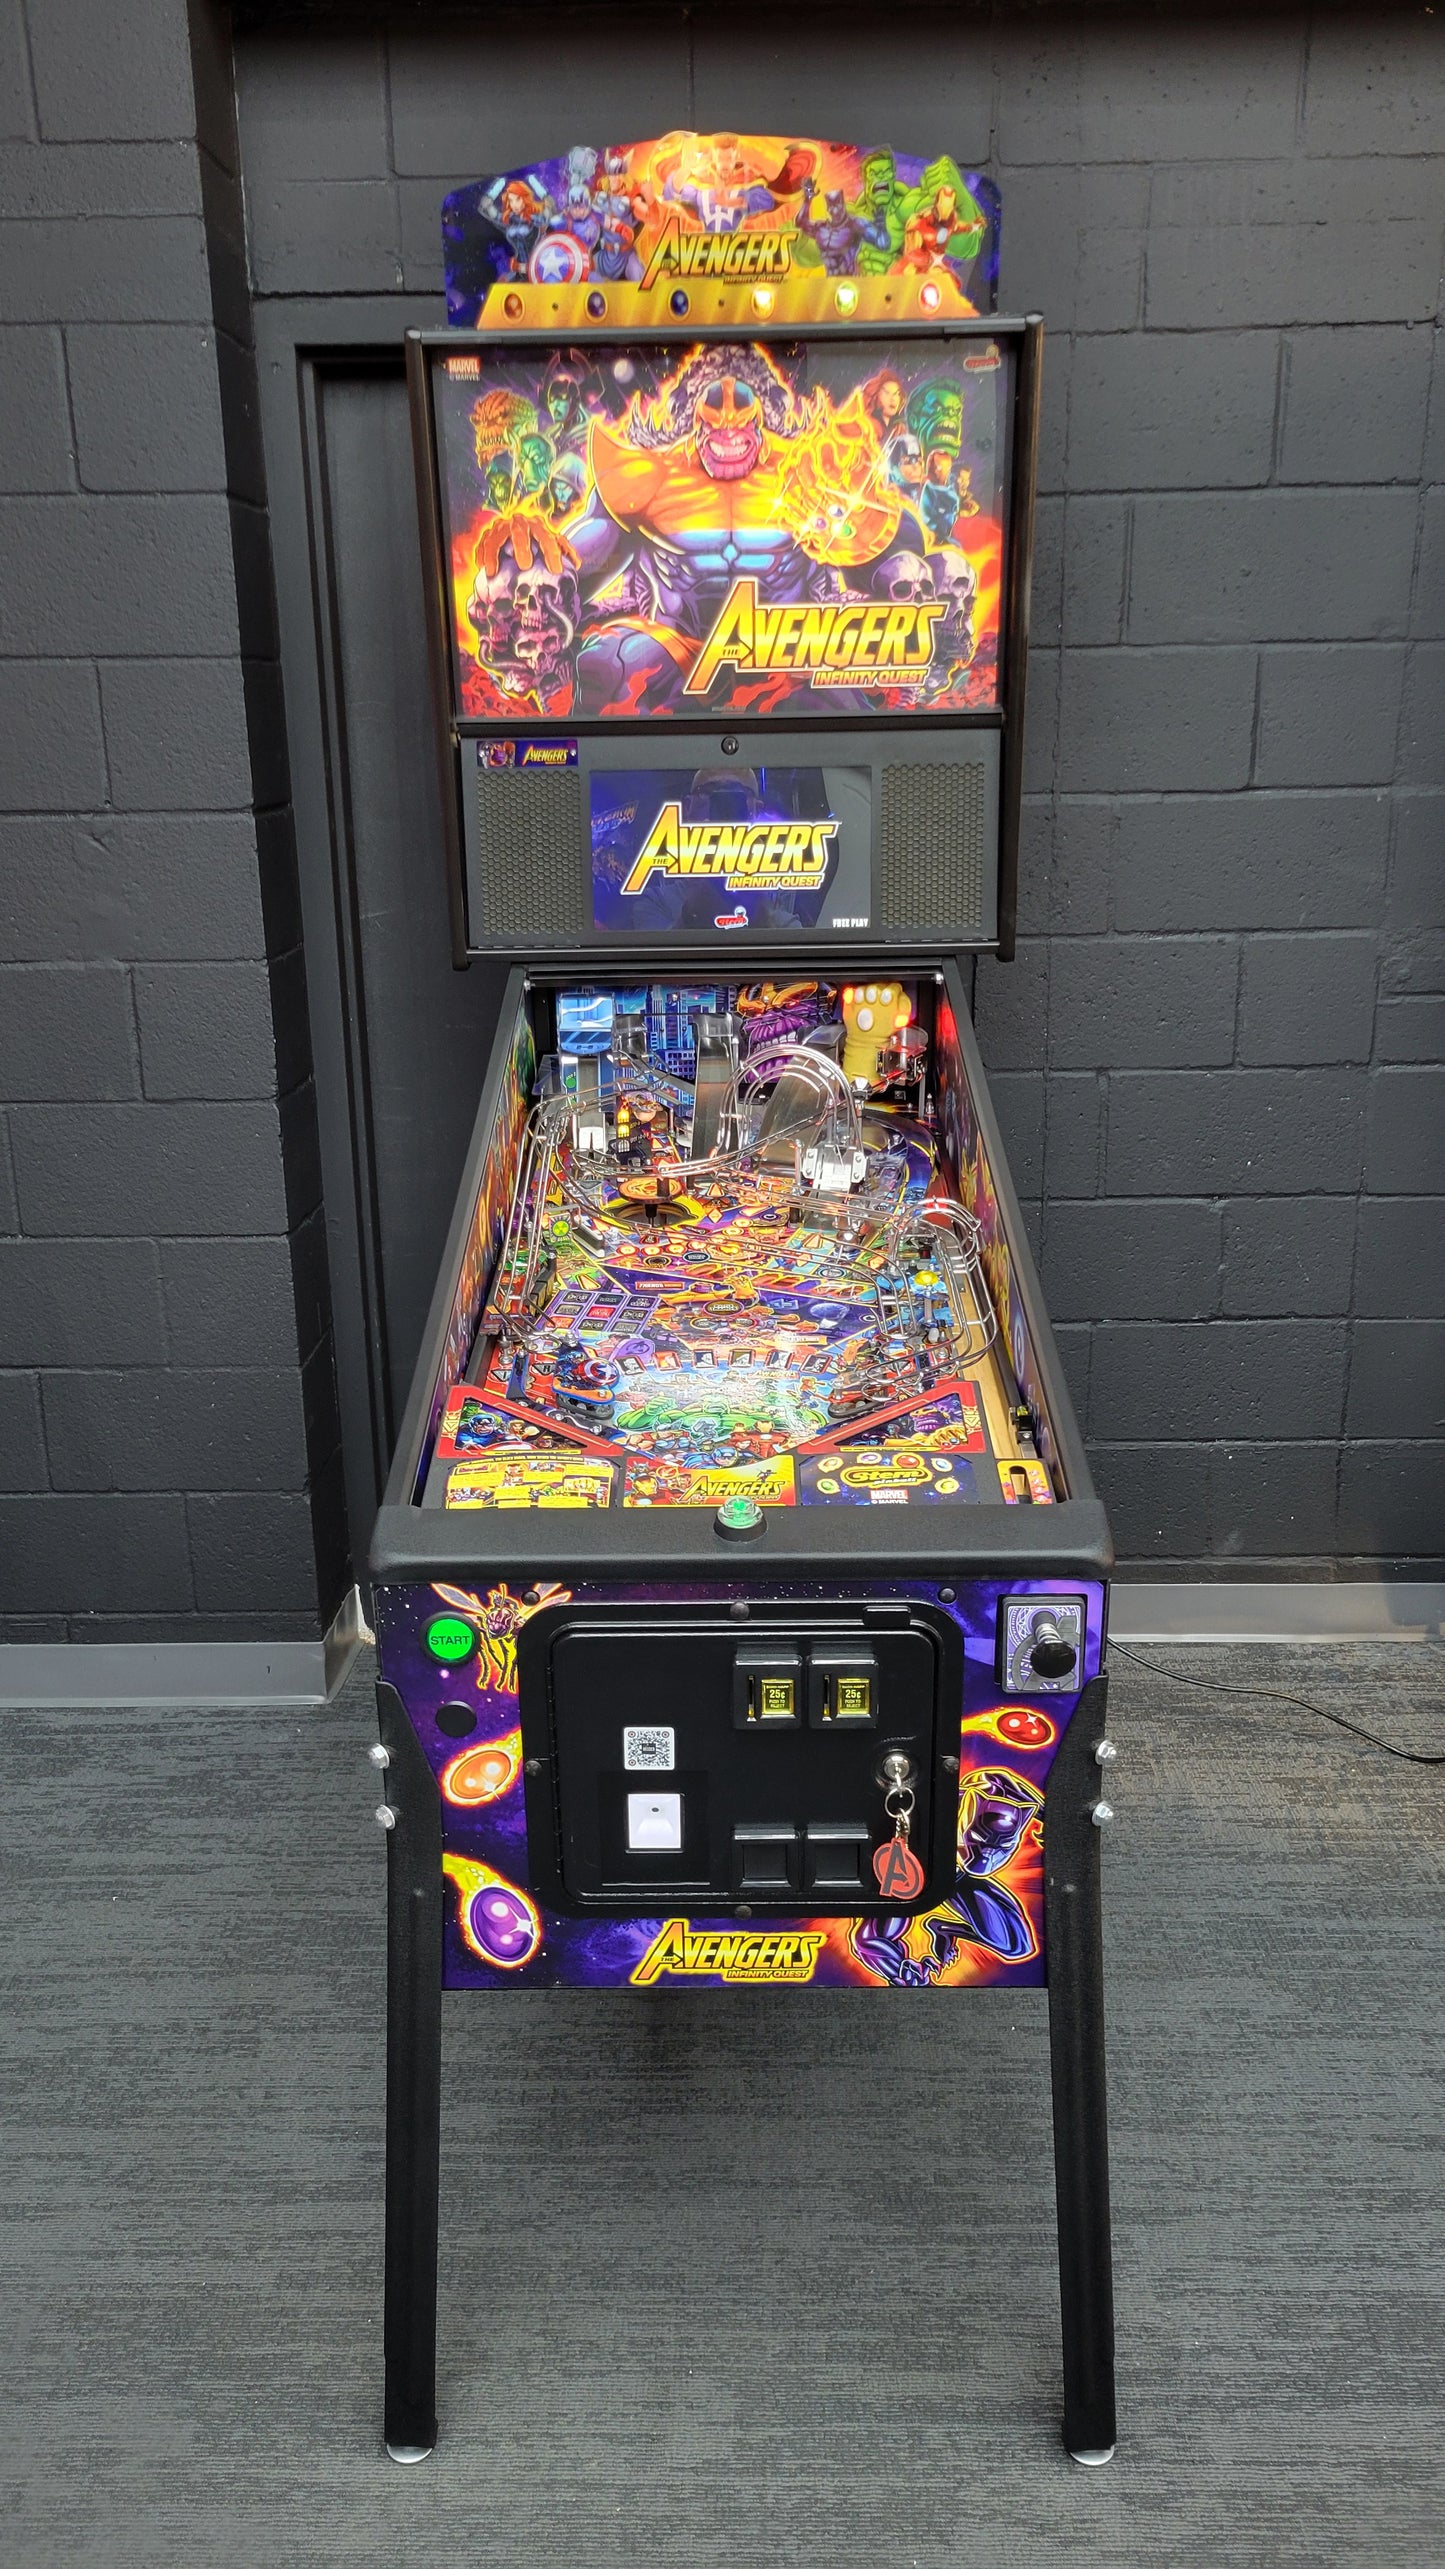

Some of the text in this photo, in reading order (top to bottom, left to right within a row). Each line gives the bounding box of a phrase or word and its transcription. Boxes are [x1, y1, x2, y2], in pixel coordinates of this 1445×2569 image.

[638, 216, 799, 292] AVENGERS
[449, 359, 480, 373] MARVEL
[688, 580, 947, 690] THE AVENGERS
[814, 671, 928, 685] INFINITY QUEST
[521, 744, 568, 766] AVENGERS
[625, 804, 838, 892] AVENGERS
[728, 876, 822, 888] INFINITY QUEST
[832, 918, 869, 928] FREE PLAY
[852, 1470, 919, 1482] Stern
[679, 1476, 785, 1501] AVENGERS
[871, 1490, 908, 1499] MARVEL
[431, 1635, 470, 1646] START
[769, 1689, 786, 1699] 25¢
[845, 1689, 862, 1699] 25¢
[636, 1922, 822, 1980] AVENGERS
[727, 1970, 809, 1978] INFINITY QUEST
